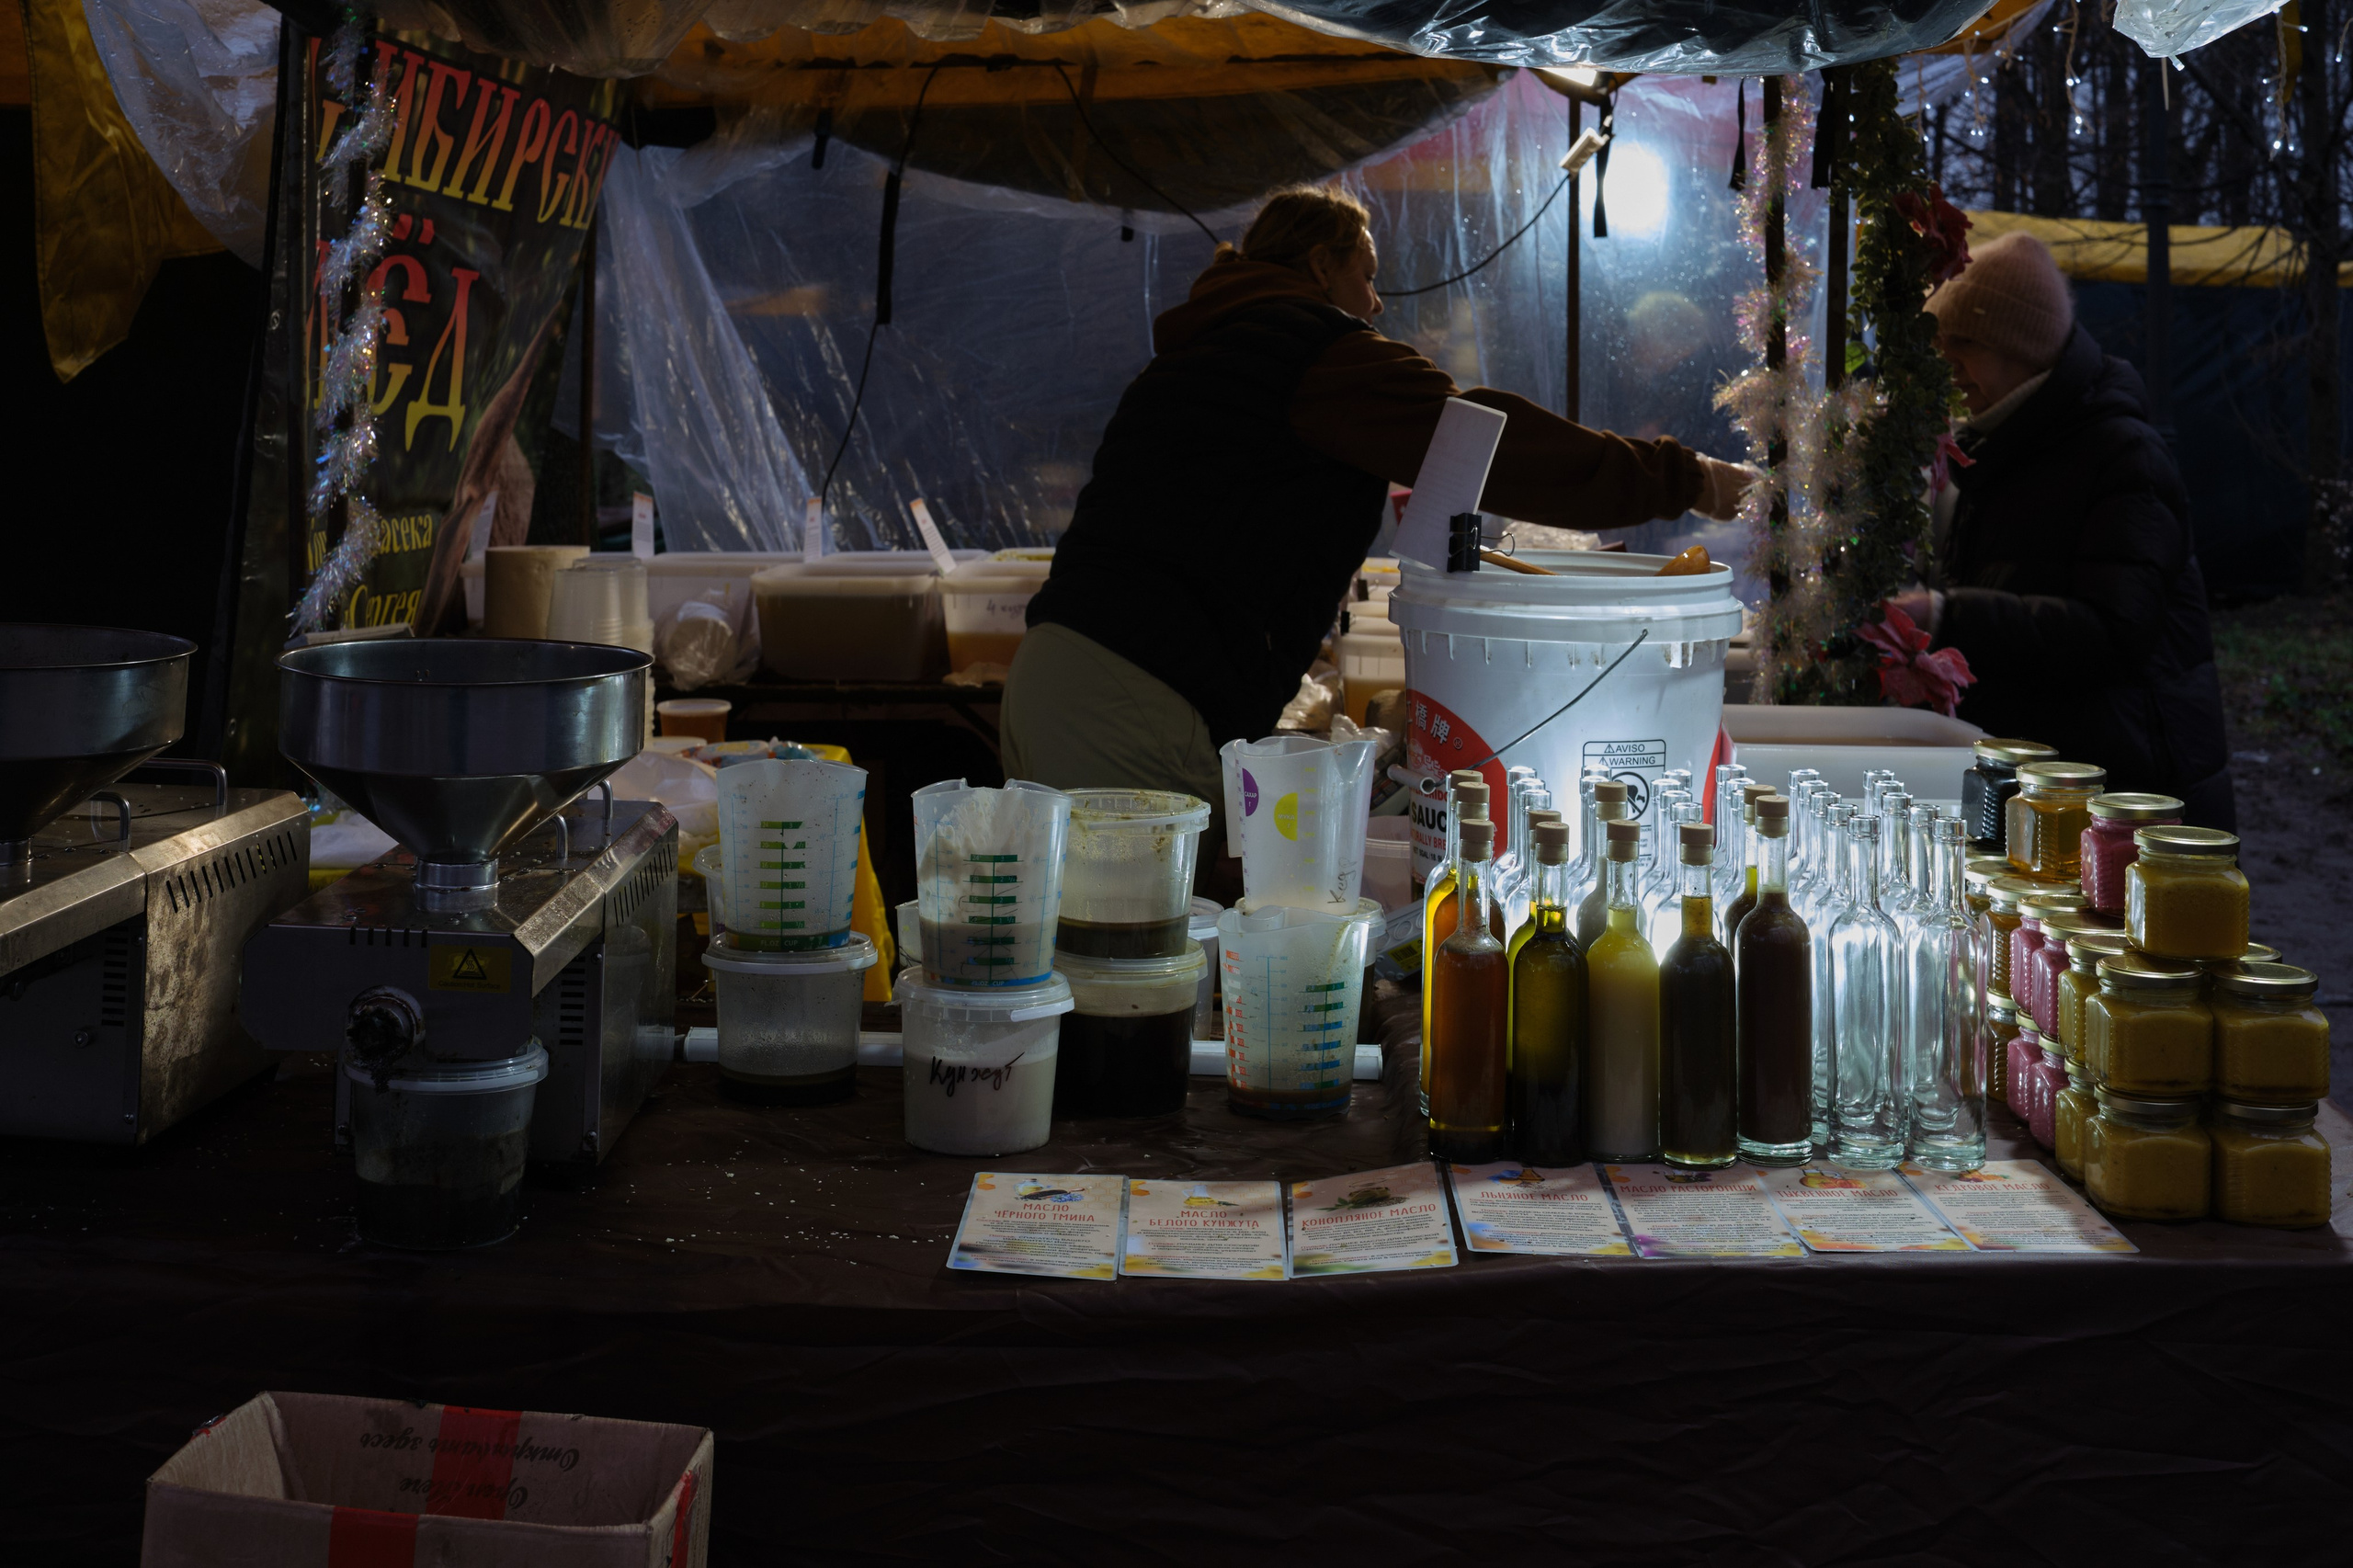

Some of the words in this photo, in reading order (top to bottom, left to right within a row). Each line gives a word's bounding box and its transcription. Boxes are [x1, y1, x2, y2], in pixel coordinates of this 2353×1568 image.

[1616, 744, 1645, 753] AVISO
[1609, 756, 1655, 766] WARNING
[1245, 790, 1257, 799] САХАР
[1620, 1185, 1666, 1193] МАСЛО
[1671, 1184, 1757, 1193] РАСТОРОПШИ
[1935, 1184, 2001, 1192] КЕДРОВОЕ
[1481, 1191, 1536, 1200] ЛЬНЯНОЕ
[1540, 1193, 1588, 1201] МАСЛО
[1850, 1189, 1898, 1198] МАСЛО
[1023, 1203, 1069, 1212] МАСЛО
[995, 1210, 1046, 1221] ЧЁРНОГО
[1053, 1212, 1095, 1222] ТМИНА
[1302, 1210, 1384, 1227] КОНОПЛЯНОЕ
[1390, 1203, 1437, 1217] МАСЛО
[1149, 1219, 1198, 1227] БЕЛОГО
[1203, 1220, 1259, 1228] КУНЖУТА
[359, 1426, 424, 1452] здесь
[429, 1436, 580, 1472] Открывать
[469, 1477, 529, 1510] Open
